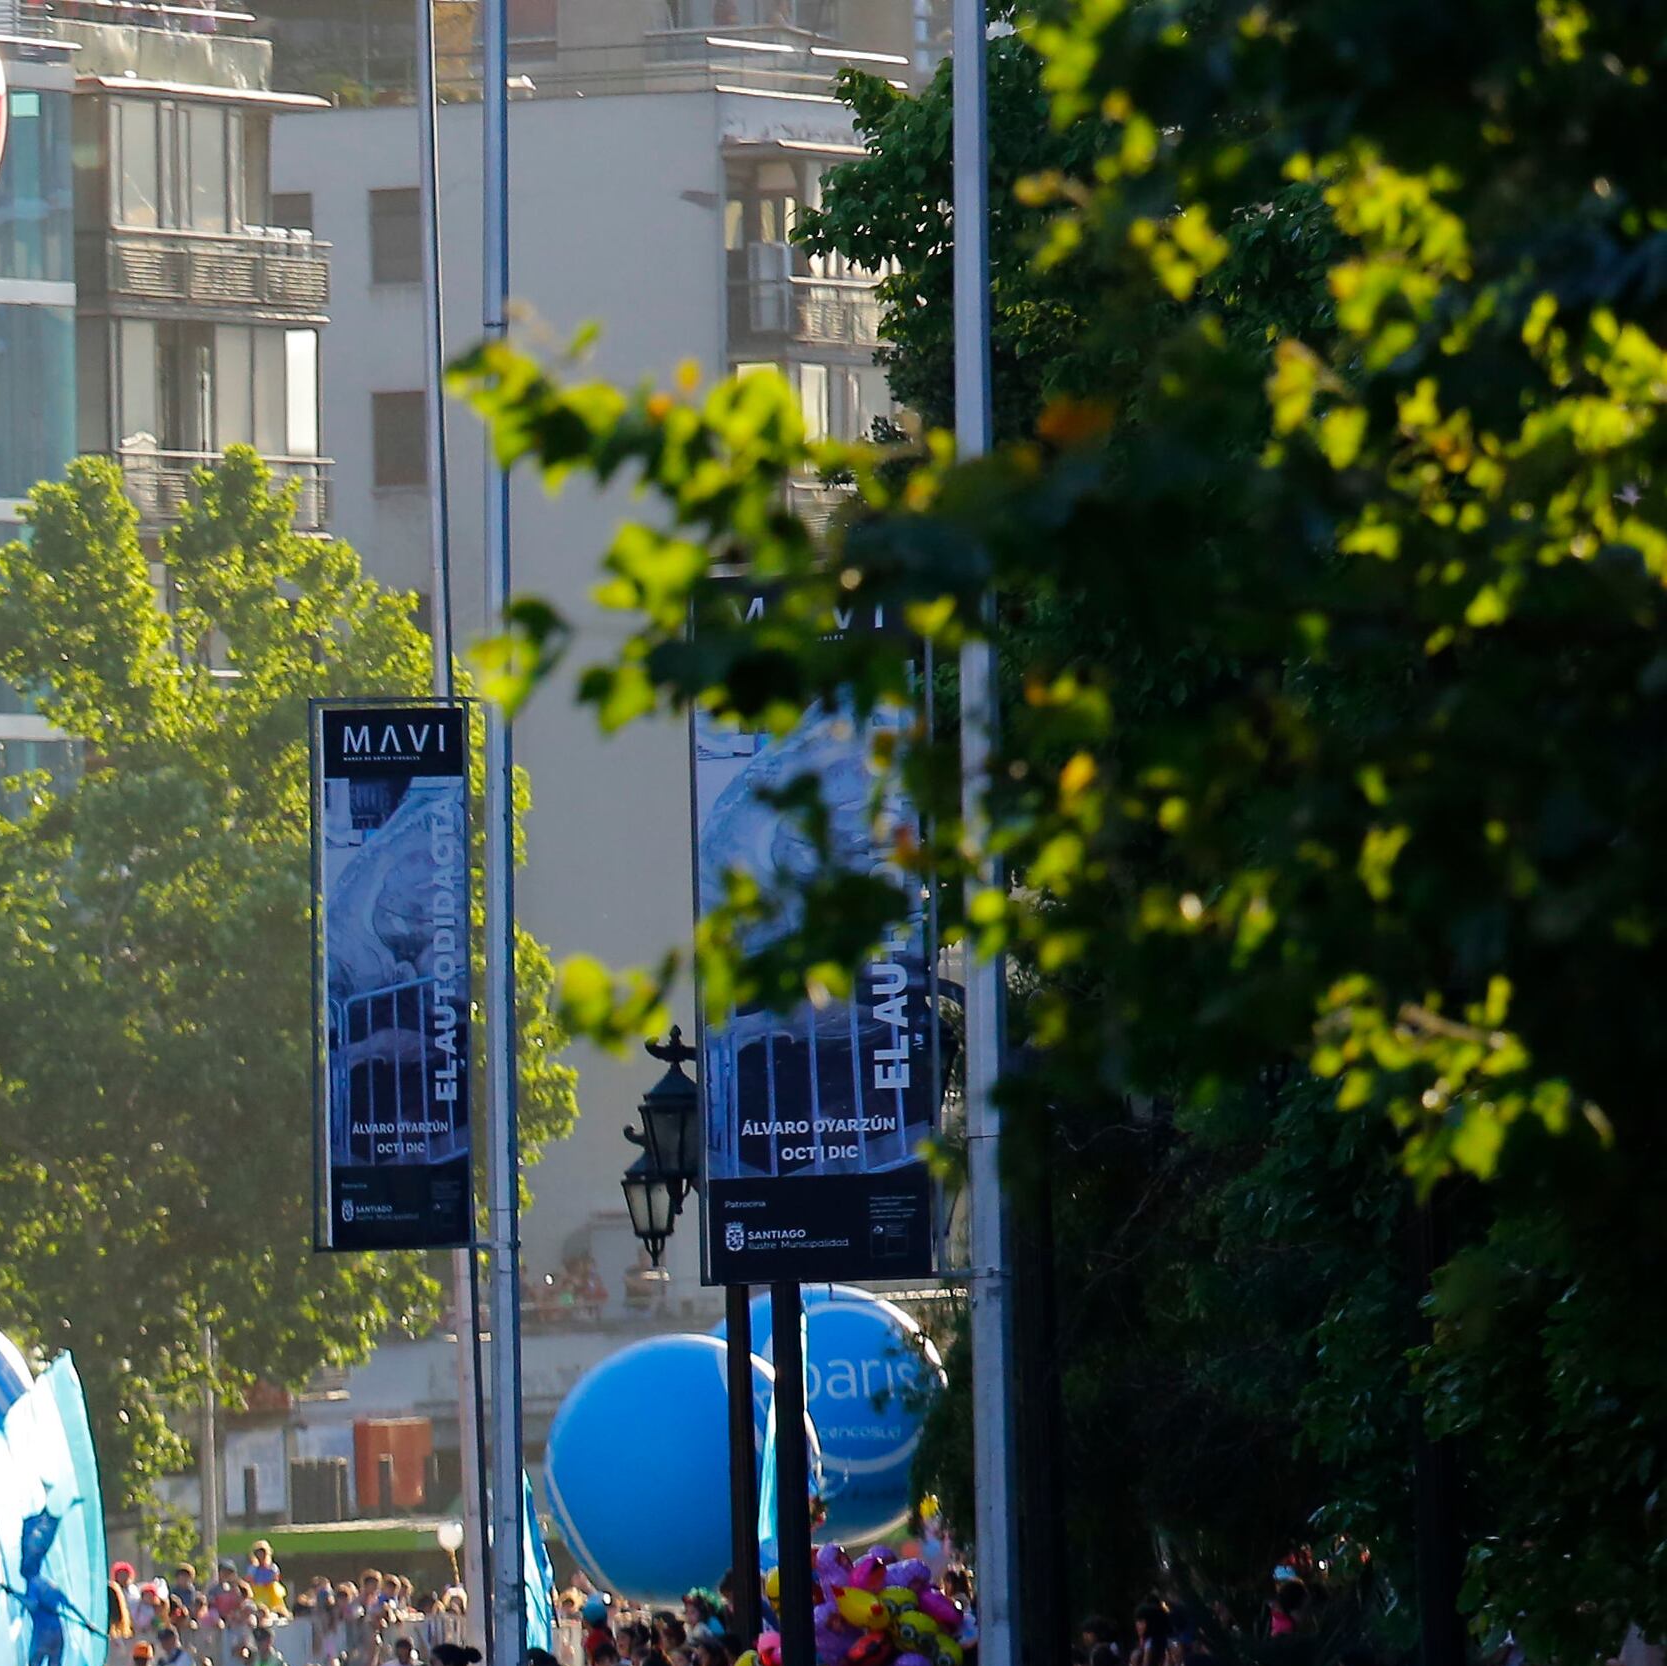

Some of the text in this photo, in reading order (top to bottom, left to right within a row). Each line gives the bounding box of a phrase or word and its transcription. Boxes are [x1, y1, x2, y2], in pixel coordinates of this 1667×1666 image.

[722, 595, 884, 630] MVI
[342, 723, 445, 754] MAVI
[351, 1118, 449, 1135] ÁLVARO OYARZÚN
[740, 1114, 896, 1137] ÁLVARO OYARZÚN
[723, 1200, 767, 1209] Patrocina
[747, 1229, 807, 1241] SANTIAGO
[780, 1237, 850, 1250] Municipalidad
